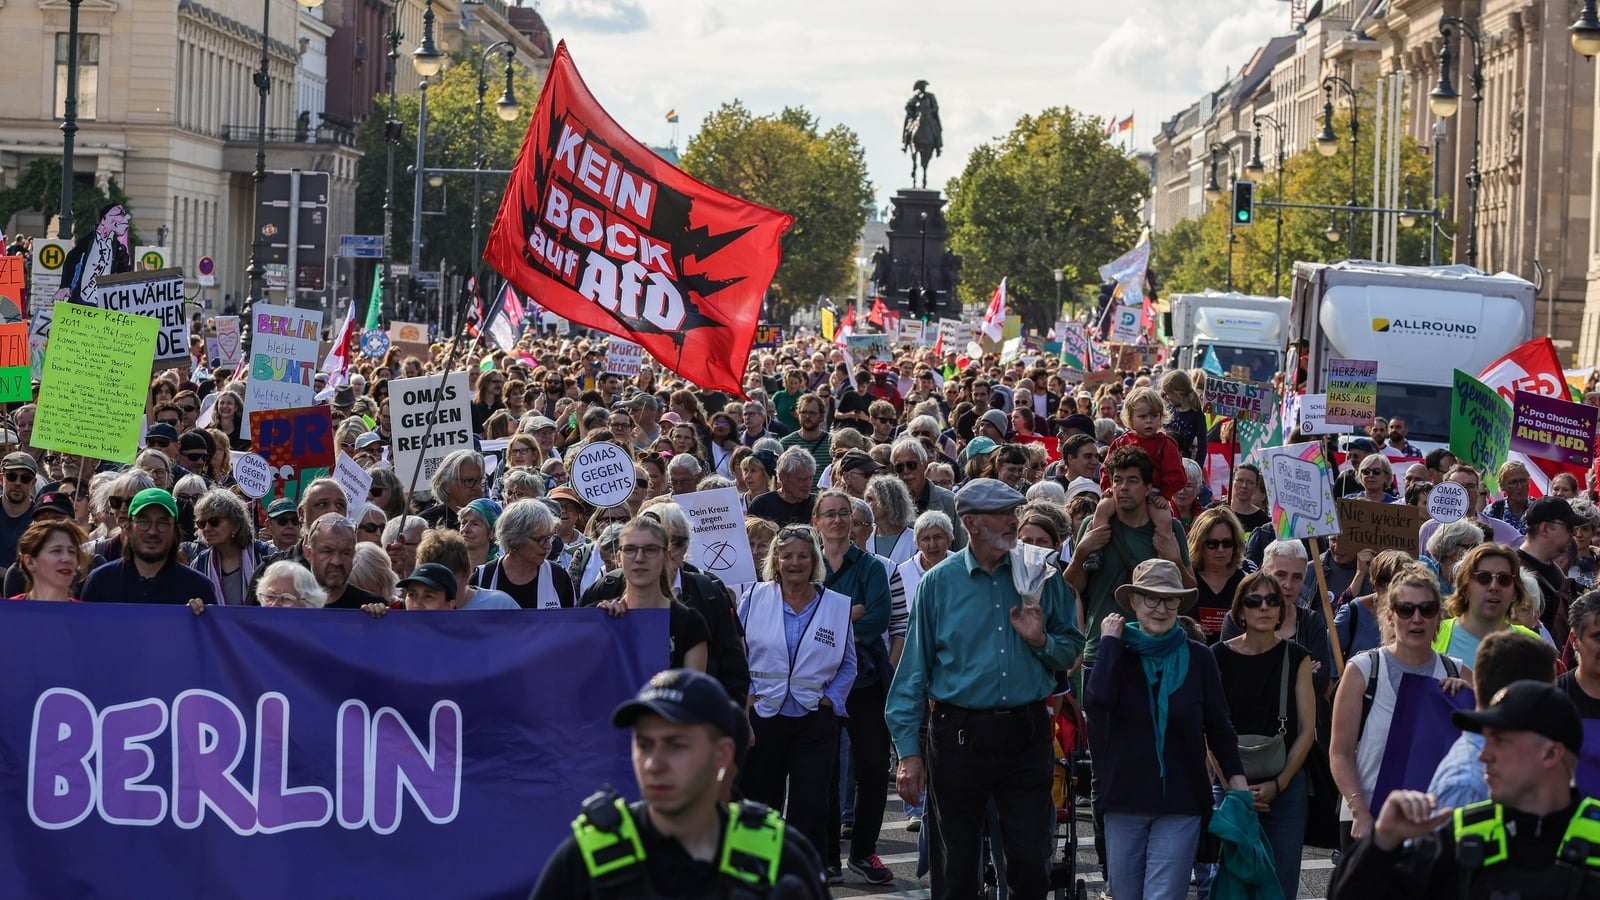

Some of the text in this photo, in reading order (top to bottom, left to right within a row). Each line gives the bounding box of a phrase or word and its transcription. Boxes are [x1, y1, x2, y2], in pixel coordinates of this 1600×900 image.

[556, 123, 652, 219] KEIN
[545, 184, 673, 277] BOCK
[530, 226, 579, 277] auf
[0, 258, 21, 284] ZE
[103, 281, 184, 311] ICH WÄHLE
[579, 250, 687, 332] AfD
[71, 306, 136, 326] roter Koffer
[60, 317, 80, 328] 2011
[135, 331, 150, 345] Opa
[756, 325, 779, 344] ÜF
[1393, 319, 1477, 334] ALLROUND
[0, 334, 27, 367] TEN
[156, 329, 185, 356] DE
[266, 338, 297, 356] bleibt
[252, 353, 315, 387] BUNT
[607, 361, 641, 374] REICHEN
[0, 375, 22, 397] N!
[253, 386, 290, 402] Vielfalt
[403, 385, 457, 405] OMAS
[1206, 378, 1239, 395] HASS
[1217, 392, 1260, 411] KEINE
[401, 407, 462, 428] GEGEN
[1518, 416, 1590, 439] Pro Demokratie.
[1530, 409, 1580, 427] Pro Choice.
[397, 429, 469, 452] RECHTS
[1517, 426, 1589, 452] Anti AfD.
[245, 455, 267, 471] OMAS
[579, 446, 617, 466] OMAS
[241, 465, 267, 482] GEGEN
[581, 462, 624, 482] GEGEN
[1278, 461, 1292, 478] FÜR
[239, 475, 266, 493] RECHTS
[585, 476, 632, 499] RECHTS
[1284, 478, 1312, 499] BUNTE
[1437, 485, 1462, 496] OMAS
[1279, 491, 1317, 515] ZUKUNFT
[1433, 495, 1461, 506] GEGEN
[690, 505, 730, 517] Dein Kreuz
[700, 515, 723, 525] gegen
[1340, 501, 1413, 528] Nie wieder
[1430, 505, 1462, 517] RECHTS
[1350, 525, 1415, 550] Faschismus
[815, 631, 834, 642] GEGEN
[818, 627, 834, 636] OMAS
[814, 636, 836, 648] RECHTS
[27, 687, 463, 836] BERLIN
